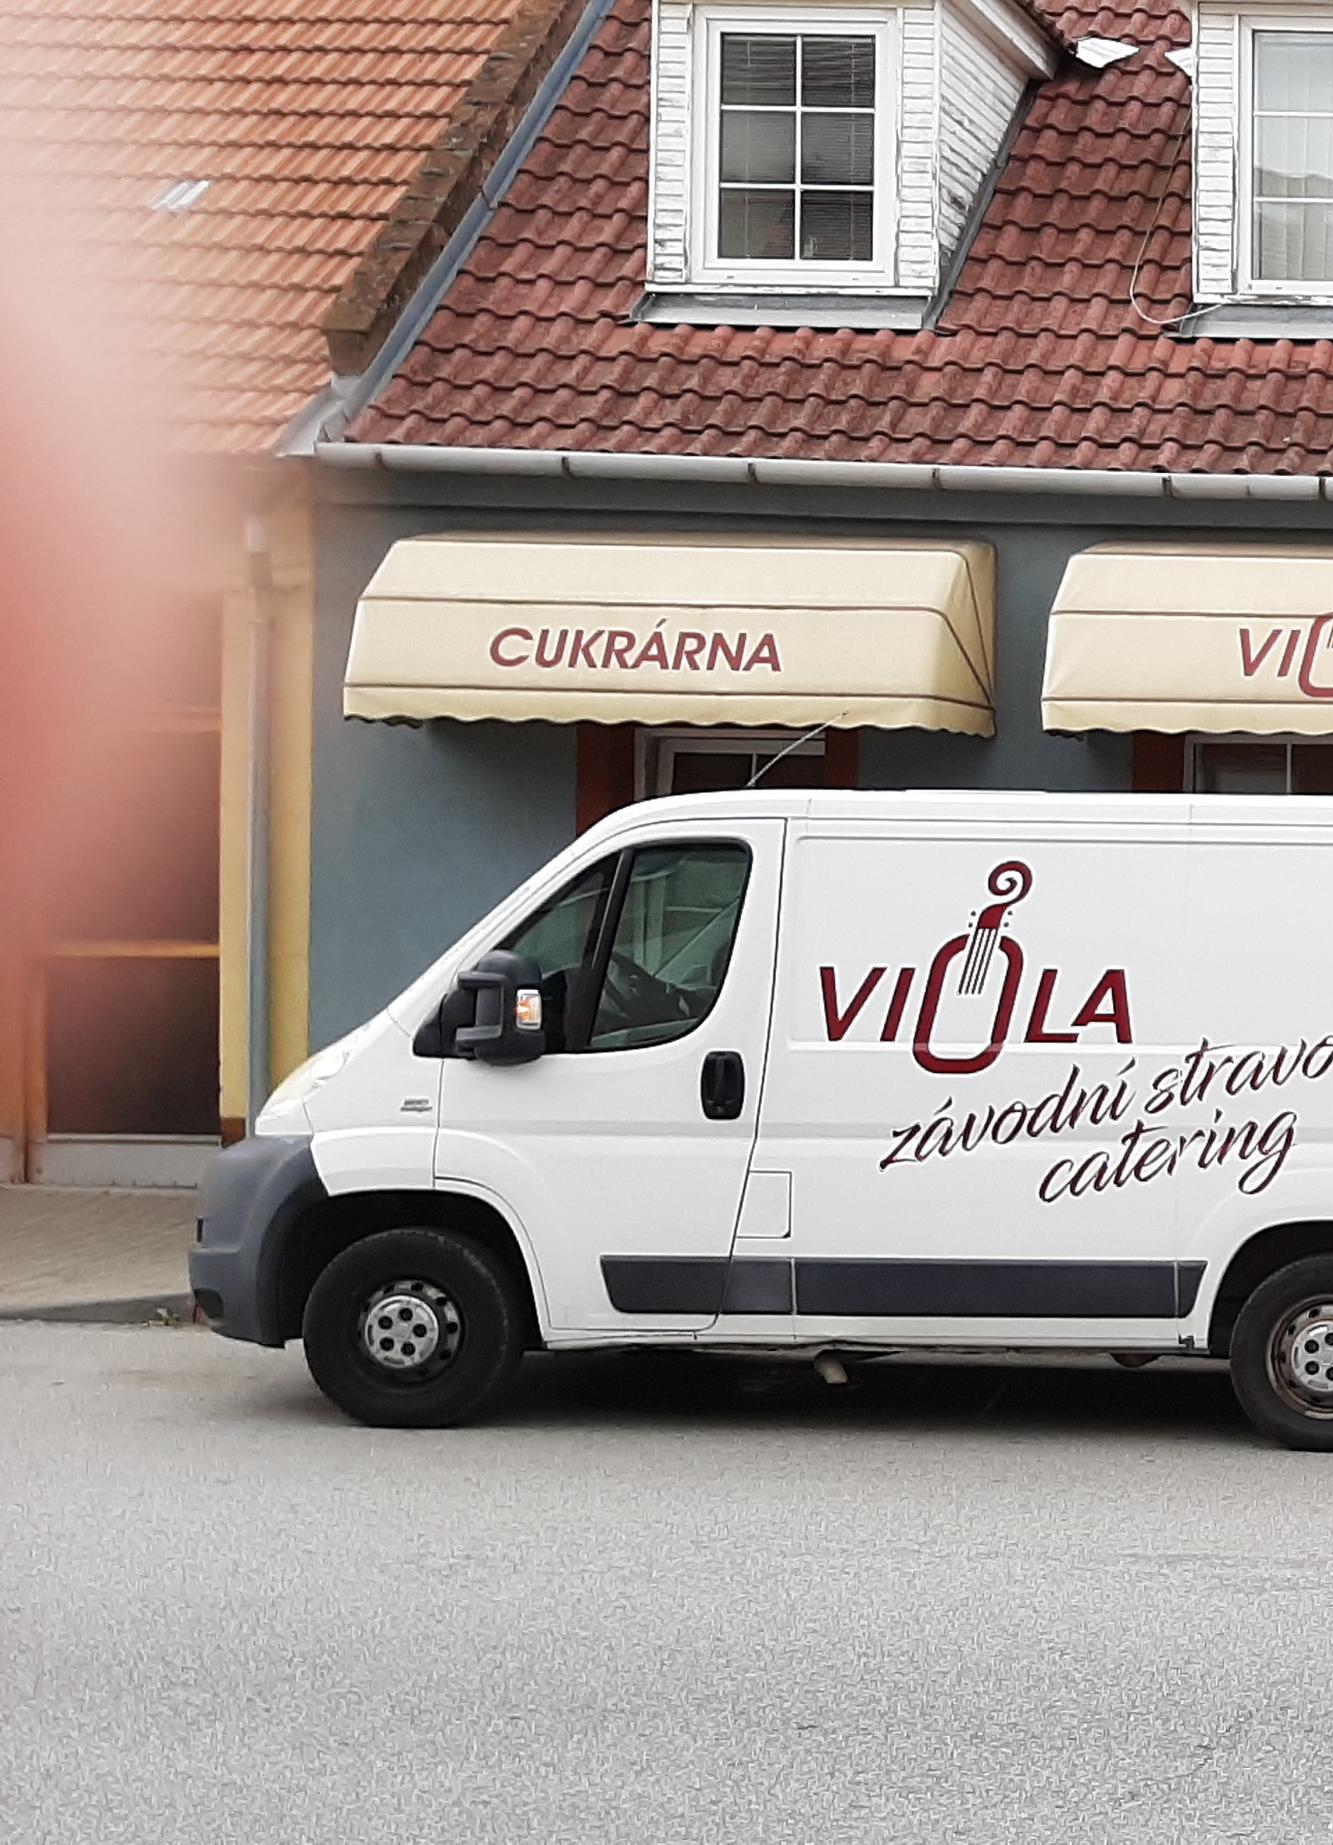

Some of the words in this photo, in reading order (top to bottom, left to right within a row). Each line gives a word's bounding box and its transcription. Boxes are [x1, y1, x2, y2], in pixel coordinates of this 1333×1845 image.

[489, 618, 782, 672] CUKRÁRNA
[819, 861, 1133, 1075] VIOLA
[880, 1058, 1136, 1170] závodní
[1038, 1110, 1296, 1203] catering
